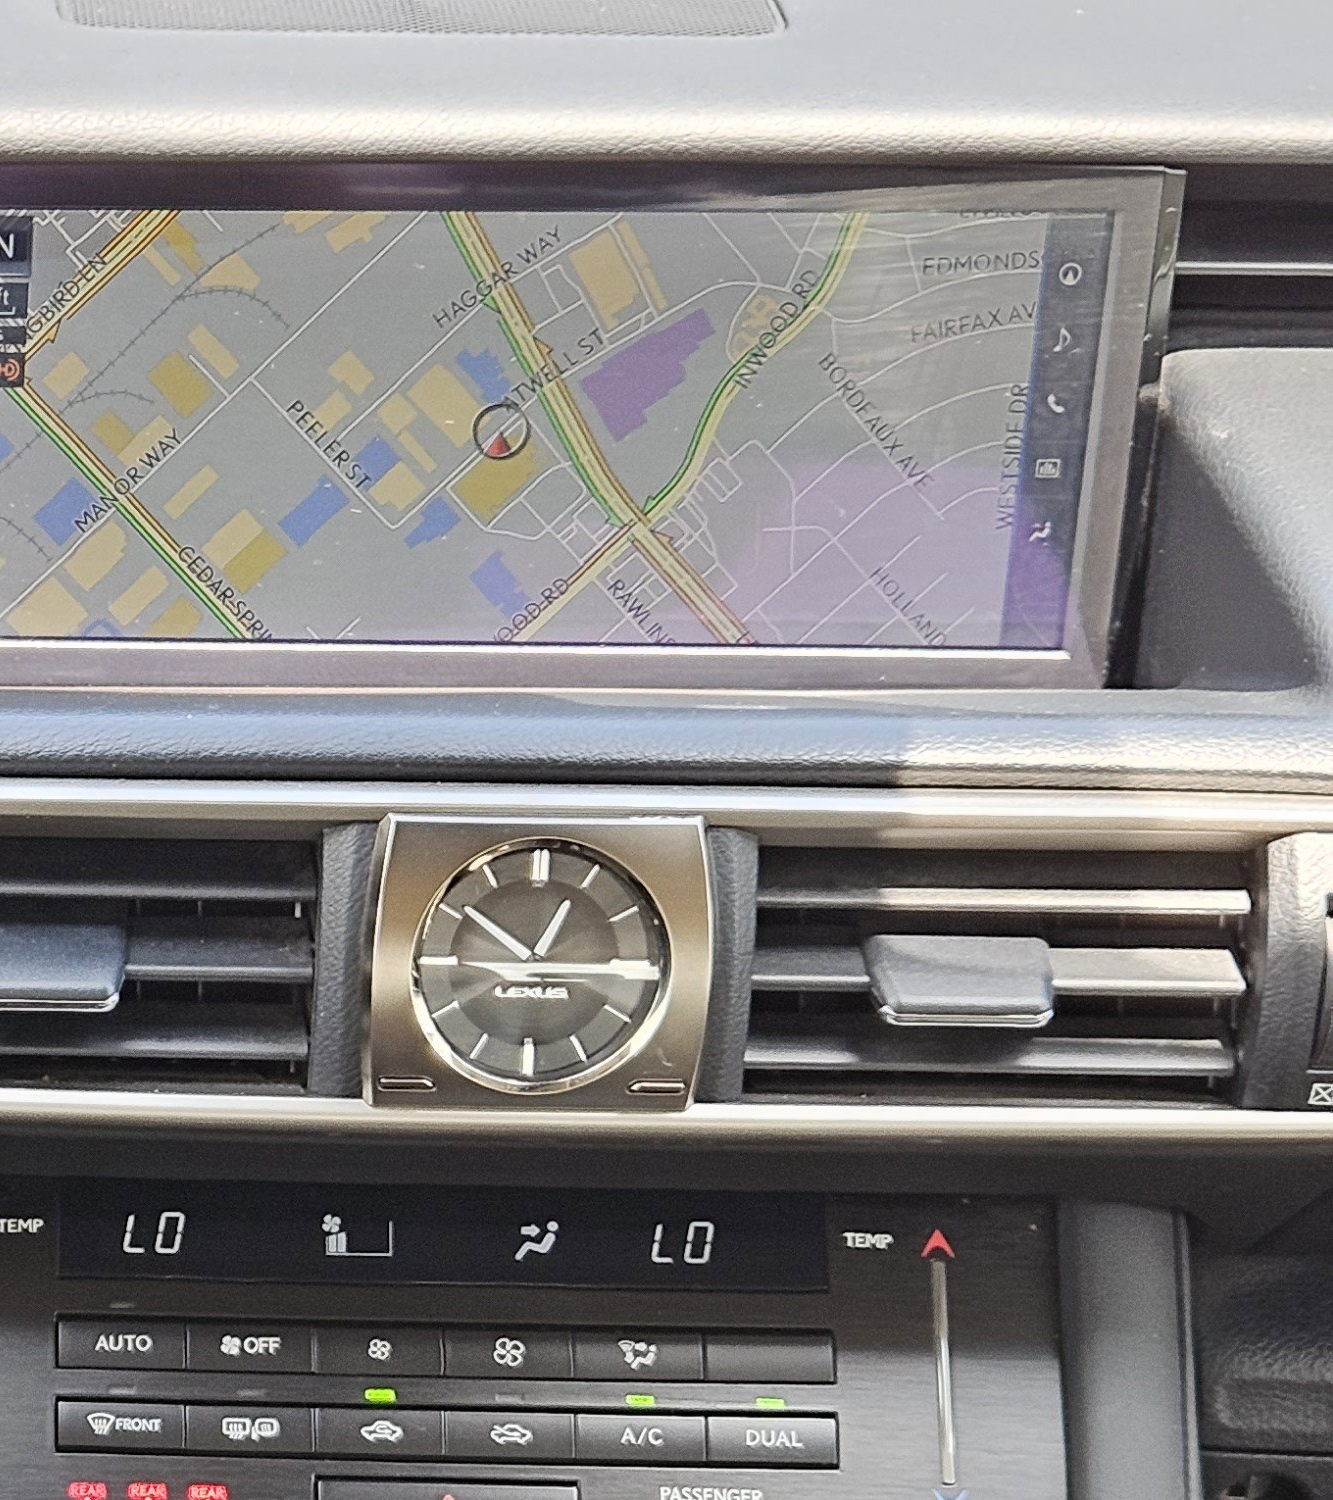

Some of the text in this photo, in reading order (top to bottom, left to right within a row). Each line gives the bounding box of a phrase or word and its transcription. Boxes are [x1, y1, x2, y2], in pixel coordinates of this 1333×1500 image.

[433, 224, 562, 328] HAGGAR WAY
[577, 327, 605, 356] ST
[734, 269, 822, 389] INWOOD RD
[910, 307, 1002, 343] FAIRFAX
[818, 352, 935, 490] BORDEAUX AVE
[286, 400, 372, 488] PEELER ST
[995, 384, 1029, 530] WESTSIDE DR
[74, 428, 183, 533] MANOR WAY
[178, 546, 235, 602] CEDAR
[540, 577, 571, 607] RD
[870, 565, 947, 646] HOLLAND
[494, 985, 570, 999] LEXUS
[123, 1212, 186, 1254] LO
[651, 1221, 715, 1264] LO
[843, 1231, 894, 1250] TEMP
[95, 1334, 154, 1353] AUTO
[243, 1337, 281, 1355] OFF
[114, 1417, 163, 1433] FRONT
[620, 1426, 664, 1447] A/C
[746, 1428, 803, 1449] DUAL
[70, 1483, 106, 1500] REAR
[130, 1483, 166, 1500] REAR
